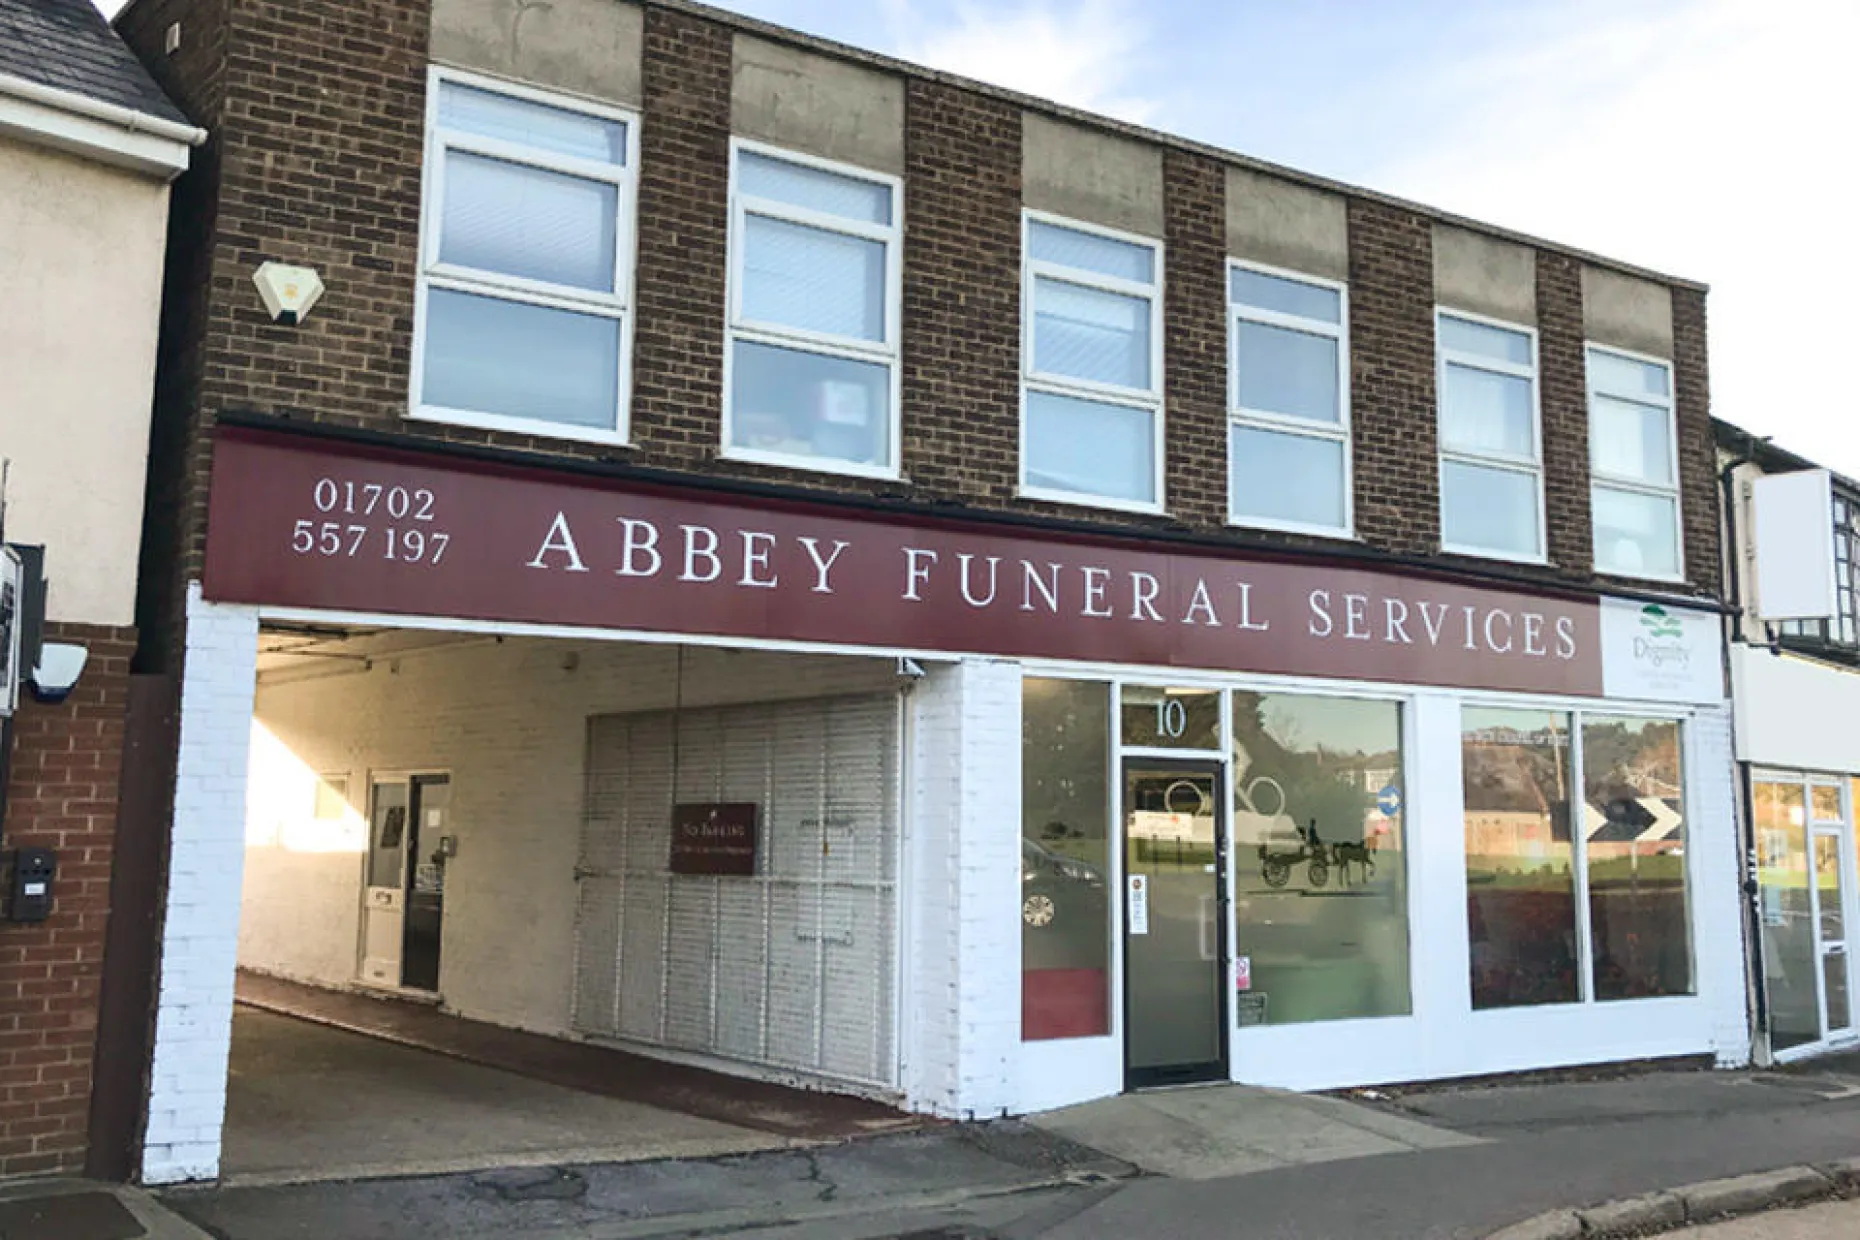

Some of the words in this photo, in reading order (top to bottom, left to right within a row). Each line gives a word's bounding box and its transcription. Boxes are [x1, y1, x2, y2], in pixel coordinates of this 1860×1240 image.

[313, 477, 435, 521] 01702
[291, 519, 367, 556] 557
[384, 528, 450, 565] 197
[526, 510, 851, 595] ABBEY
[900, 546, 1271, 632] FUNERAL
[1308, 588, 1577, 660] SERVICES
[1156, 698, 1186, 738] 10
